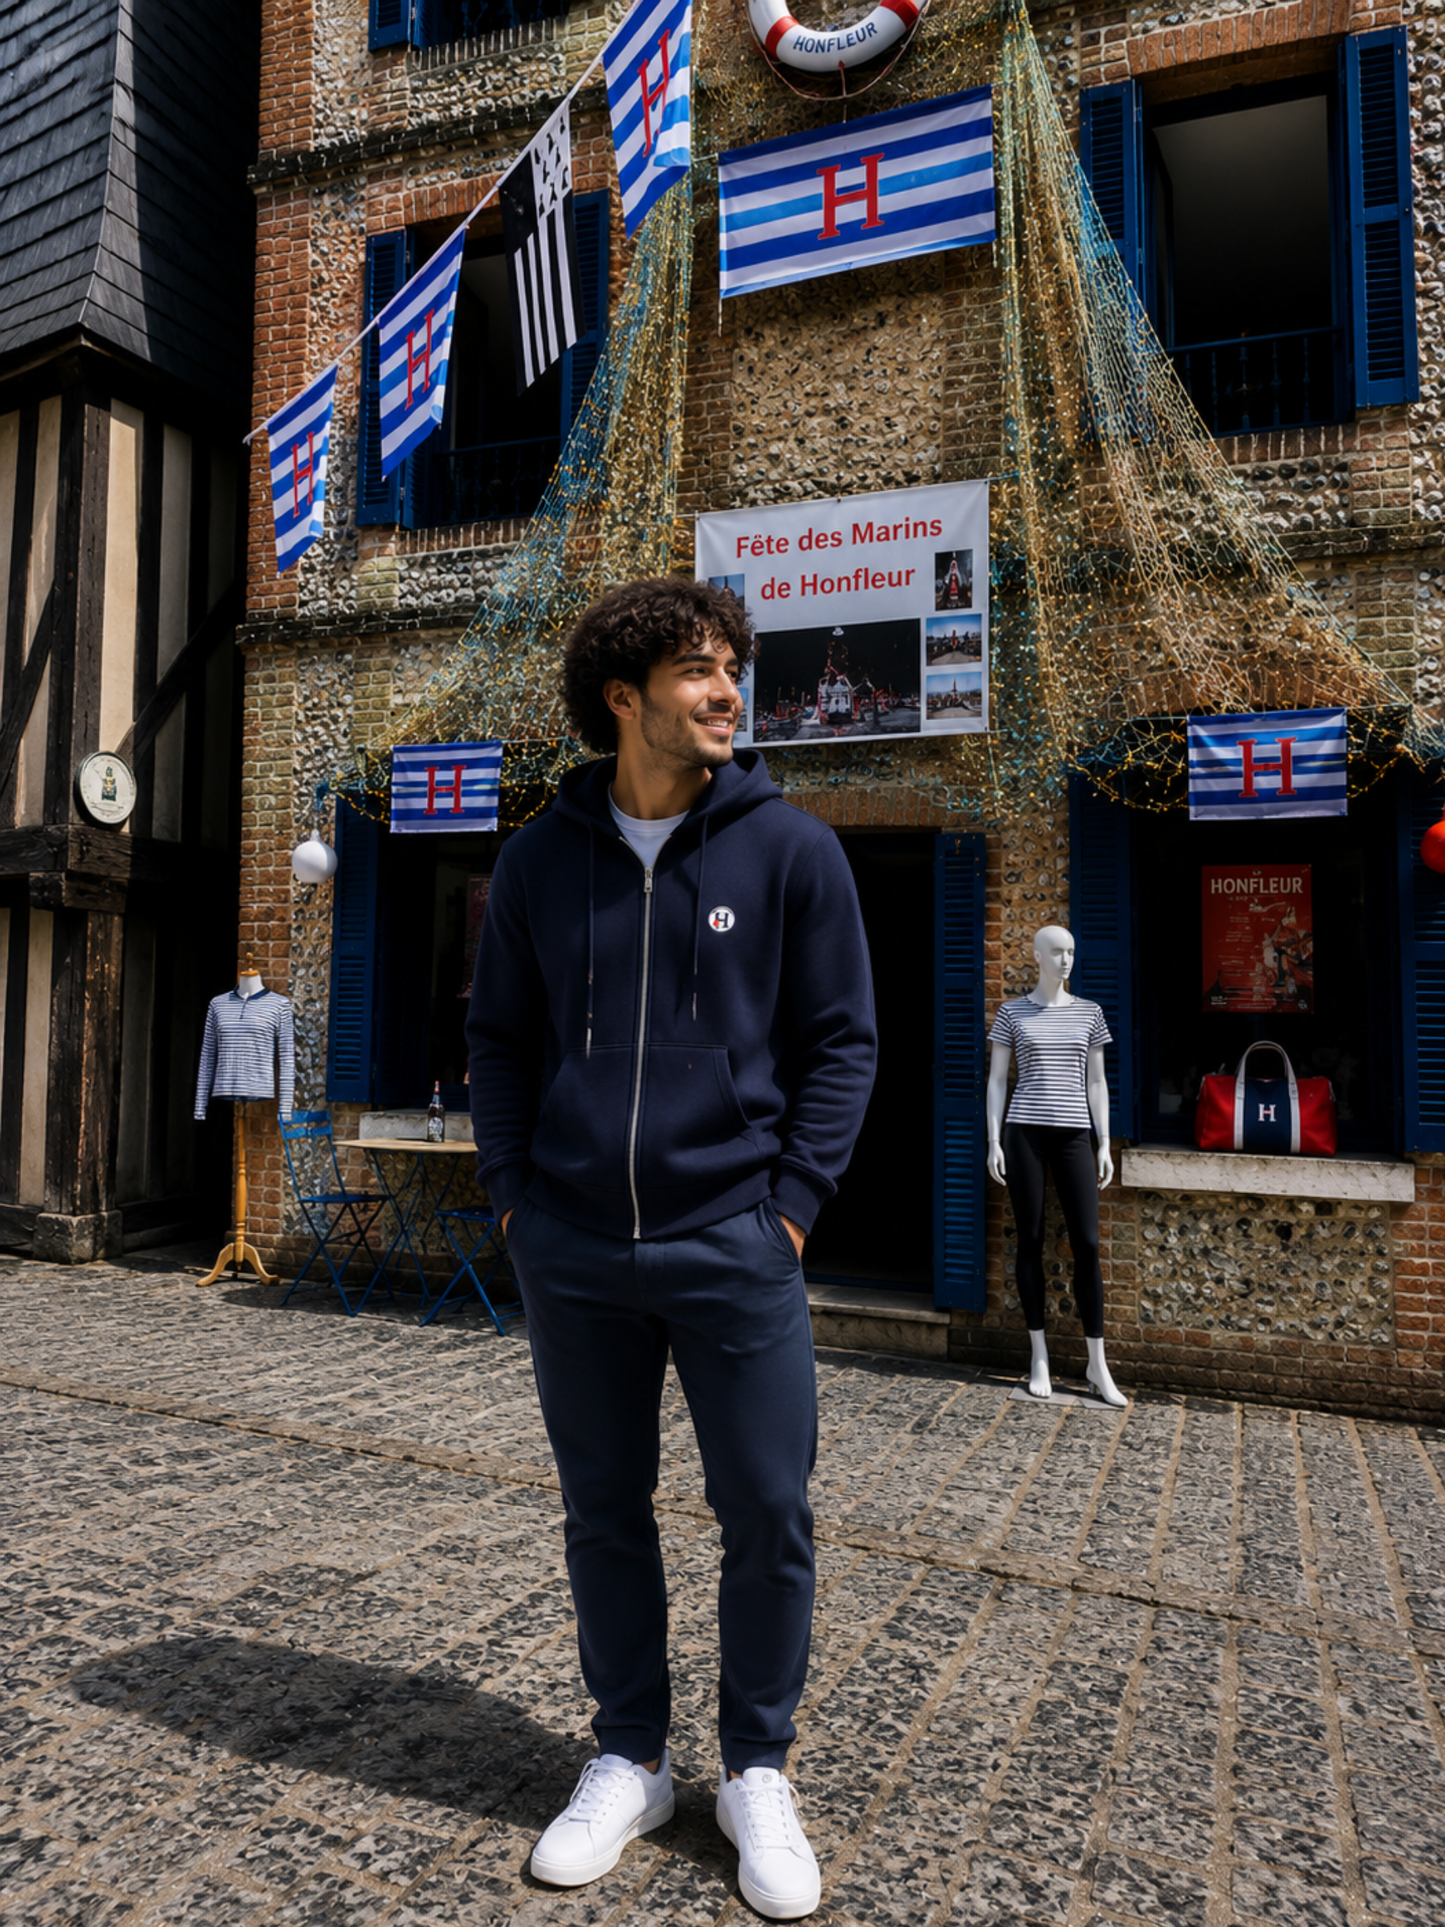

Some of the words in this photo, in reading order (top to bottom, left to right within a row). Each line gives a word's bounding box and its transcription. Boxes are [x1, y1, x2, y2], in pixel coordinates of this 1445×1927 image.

[792, 21, 878, 54] HONFLEUR
[637, 29, 671, 157] H
[817, 152, 885, 240] H
[405, 308, 435, 410] H
[291, 431, 314, 518] H
[736, 533, 790, 558] Fête
[798, 527, 843, 551] des
[851, 516, 943, 545] Marins
[760, 577, 791, 600] de
[800, 567, 916, 596] Honfleur
[424, 765, 467, 814] H
[1236, 737, 1297, 797] H
[1211, 877, 1303, 894] HONFLEUR
[1258, 1103, 1277, 1122] H
